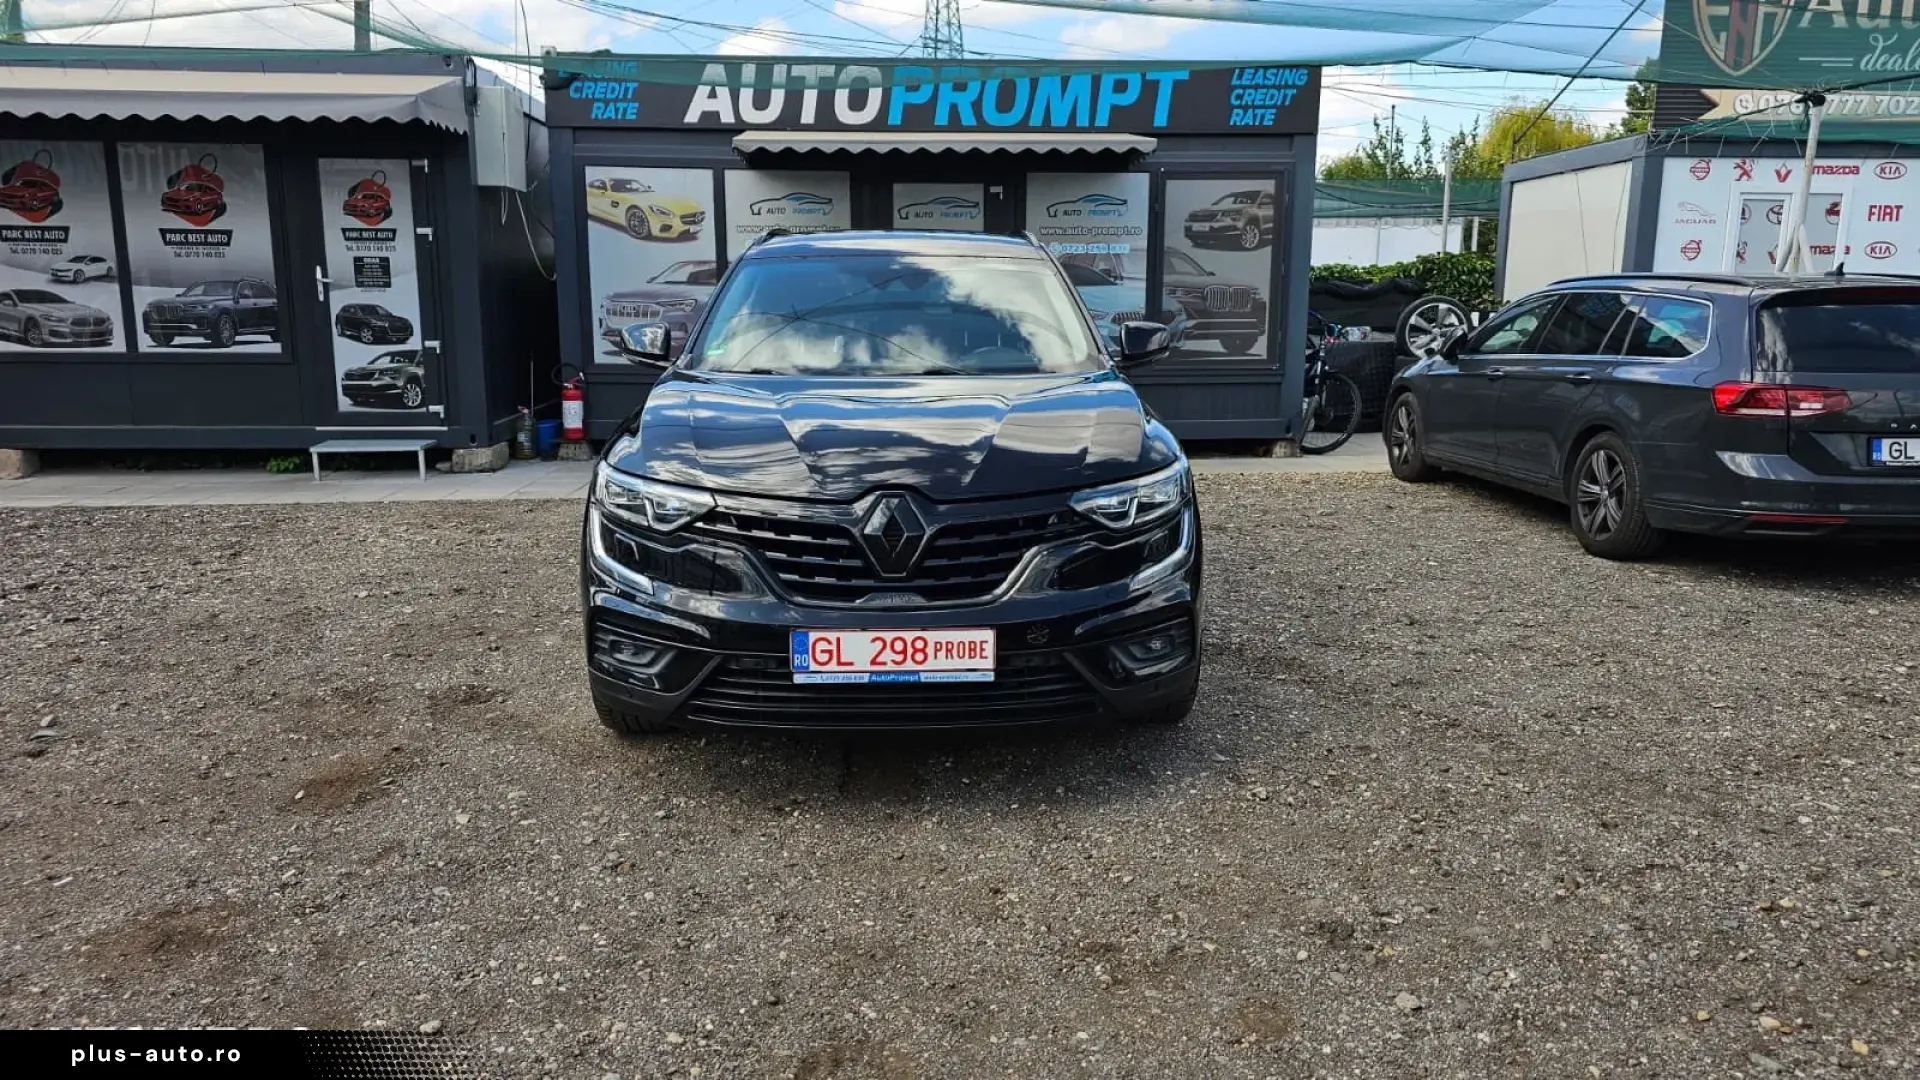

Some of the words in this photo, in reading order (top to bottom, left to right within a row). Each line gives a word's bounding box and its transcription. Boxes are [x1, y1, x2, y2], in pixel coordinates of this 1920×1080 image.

[1231, 68, 1309, 86] LEASING
[569, 80, 640, 99] CREDIT
[1230, 88, 1296, 106] CREDIT
[591, 101, 640, 119] RATE
[1229, 108, 1276, 126] RATE
[1812, 165, 1860, 175] mazda
[1879, 166, 1901, 175] KIA
[766, 207, 786, 215] AUTO
[914, 211, 934, 219] AUTO
[1062, 209, 1082, 217] AUTO
[1088, 209, 1117, 217] PROMPT
[1868, 204, 1904, 222] FIAT
[2, 230, 22, 239] PARC
[24, 230, 42, 239] BEST
[43, 230, 66, 240] AUTO
[1040, 226, 1143, 237] www.auto-prompt.ro
[166, 233, 186, 242] PARC
[187, 233, 206, 242] BEST
[207, 233, 228, 243] AUTO
[1810, 245, 1851, 255] maza
[1870, 245, 1892, 255] KIA
[1889, 441, 1915, 460] GL
[811, 636, 854, 667] GL
[869, 635, 929, 667] 298
[933, 640, 989, 660] PROBE
[794, 654, 809, 667] RO
[871, 674, 920, 683] AutoPrompt
